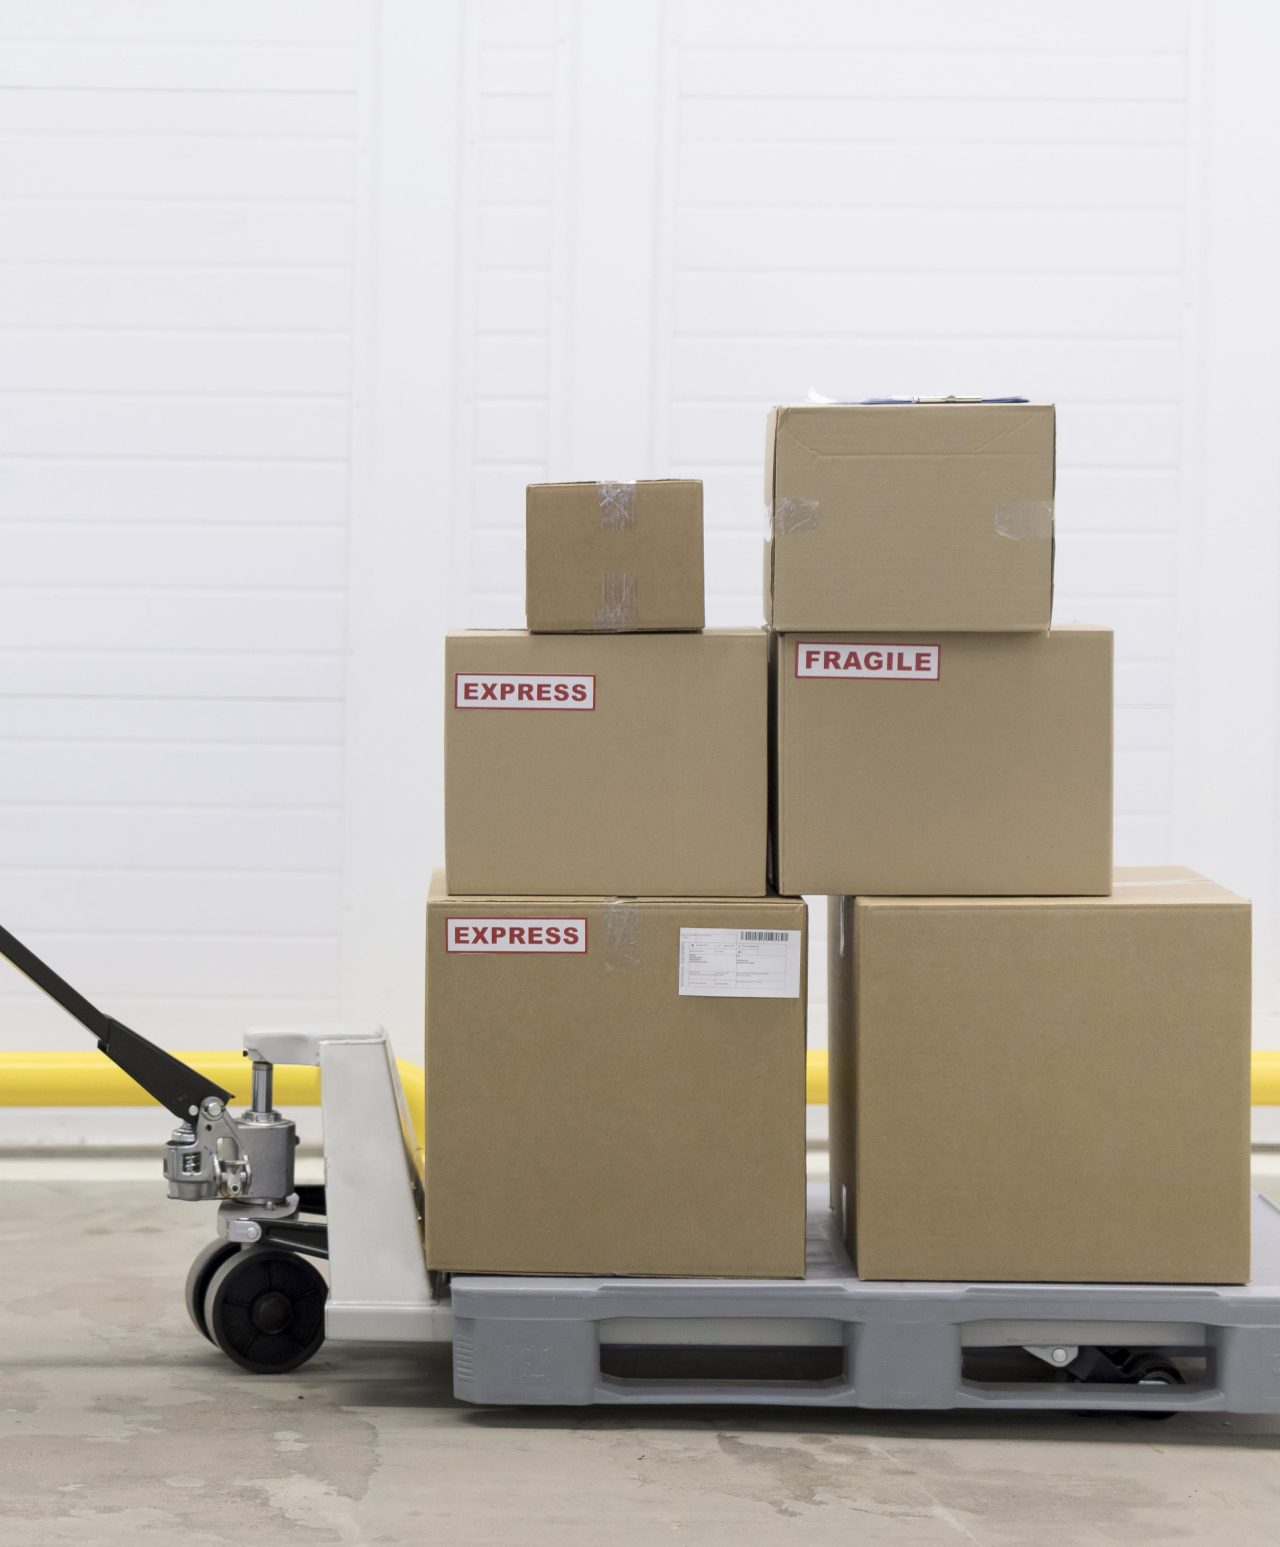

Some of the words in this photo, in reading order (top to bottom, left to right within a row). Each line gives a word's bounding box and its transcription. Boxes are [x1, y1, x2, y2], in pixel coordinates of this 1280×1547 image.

[805, 650, 932, 672] FRAGILE
[463, 682, 588, 702] EXPRESS
[454, 926, 579, 945] EXPRESS
